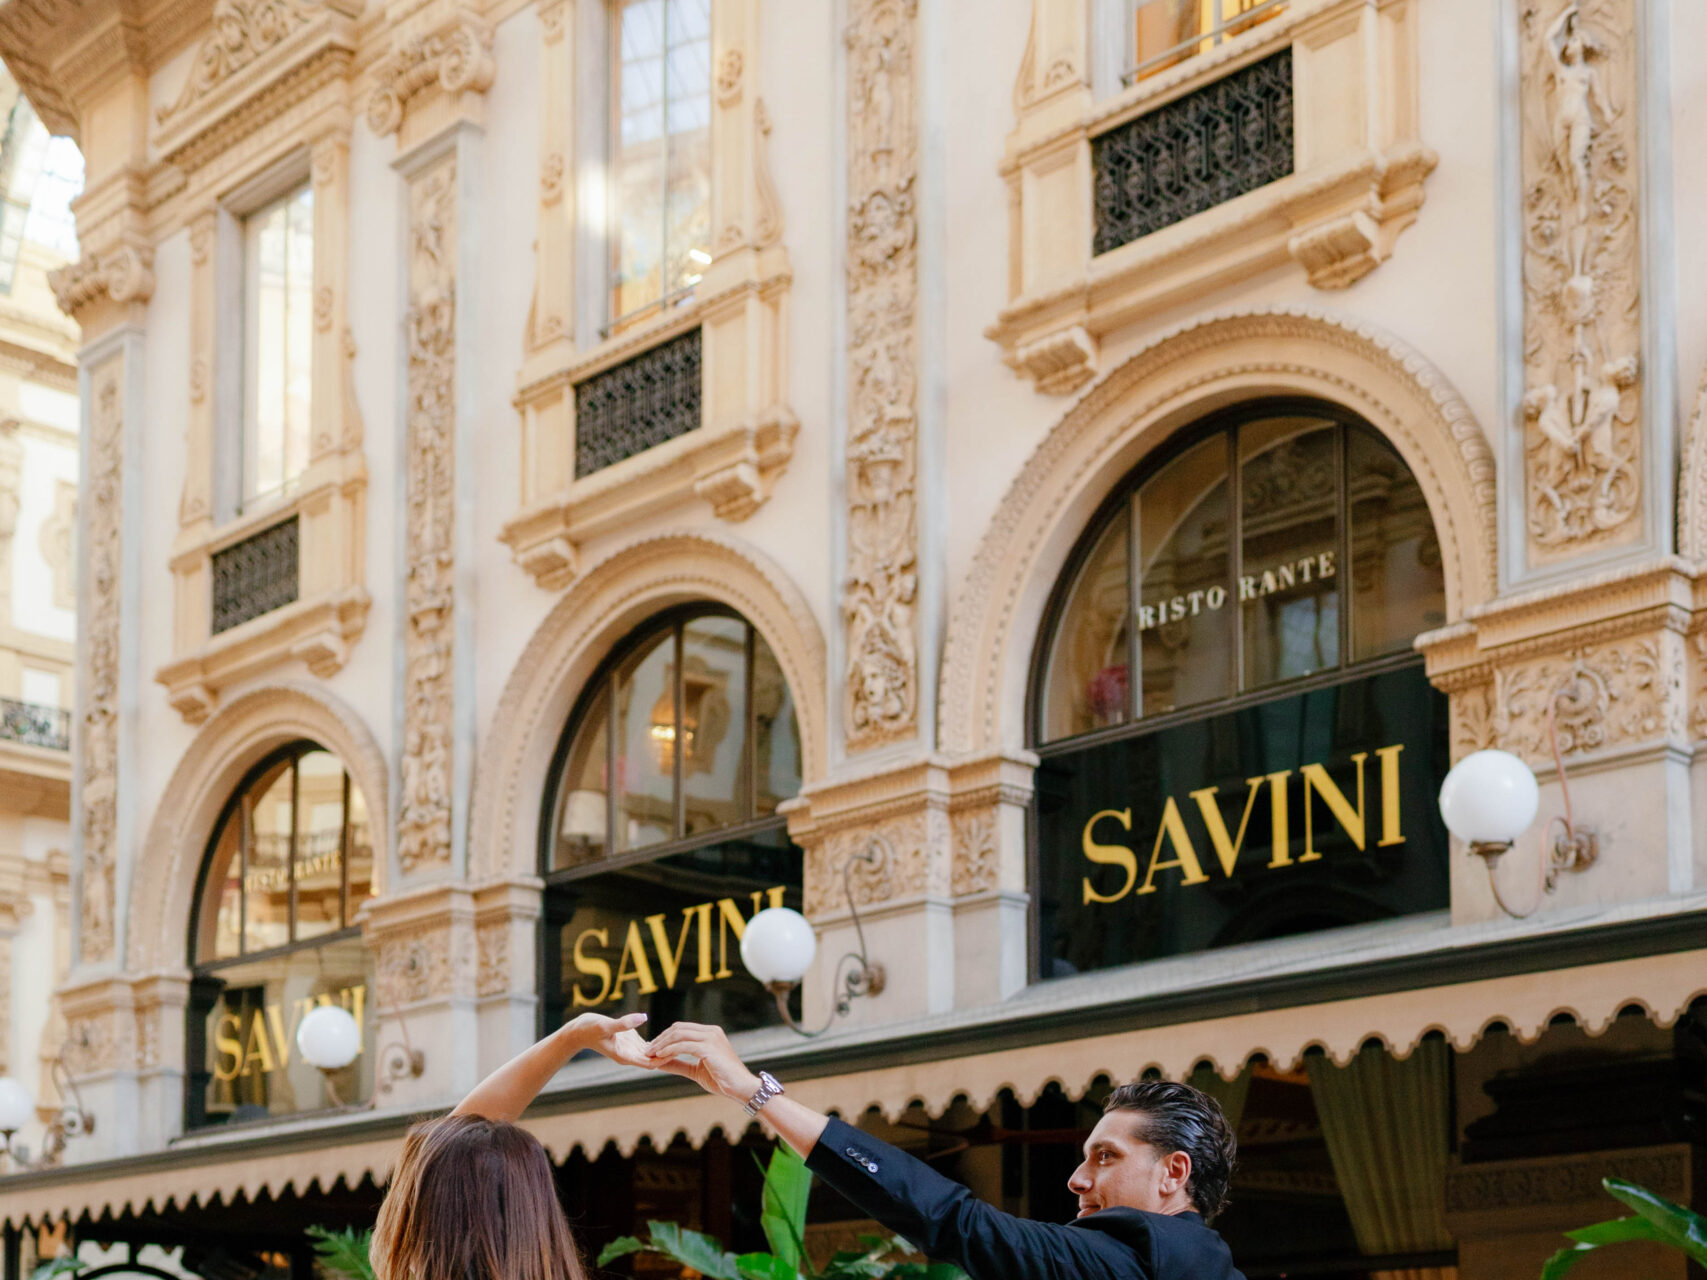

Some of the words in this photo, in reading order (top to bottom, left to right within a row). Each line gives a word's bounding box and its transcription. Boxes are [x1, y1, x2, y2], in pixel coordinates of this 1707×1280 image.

[1082, 744, 1406, 906] SAVINI
[572, 886, 787, 1008] SAVIN
[215, 985, 365, 1081] SAVI
